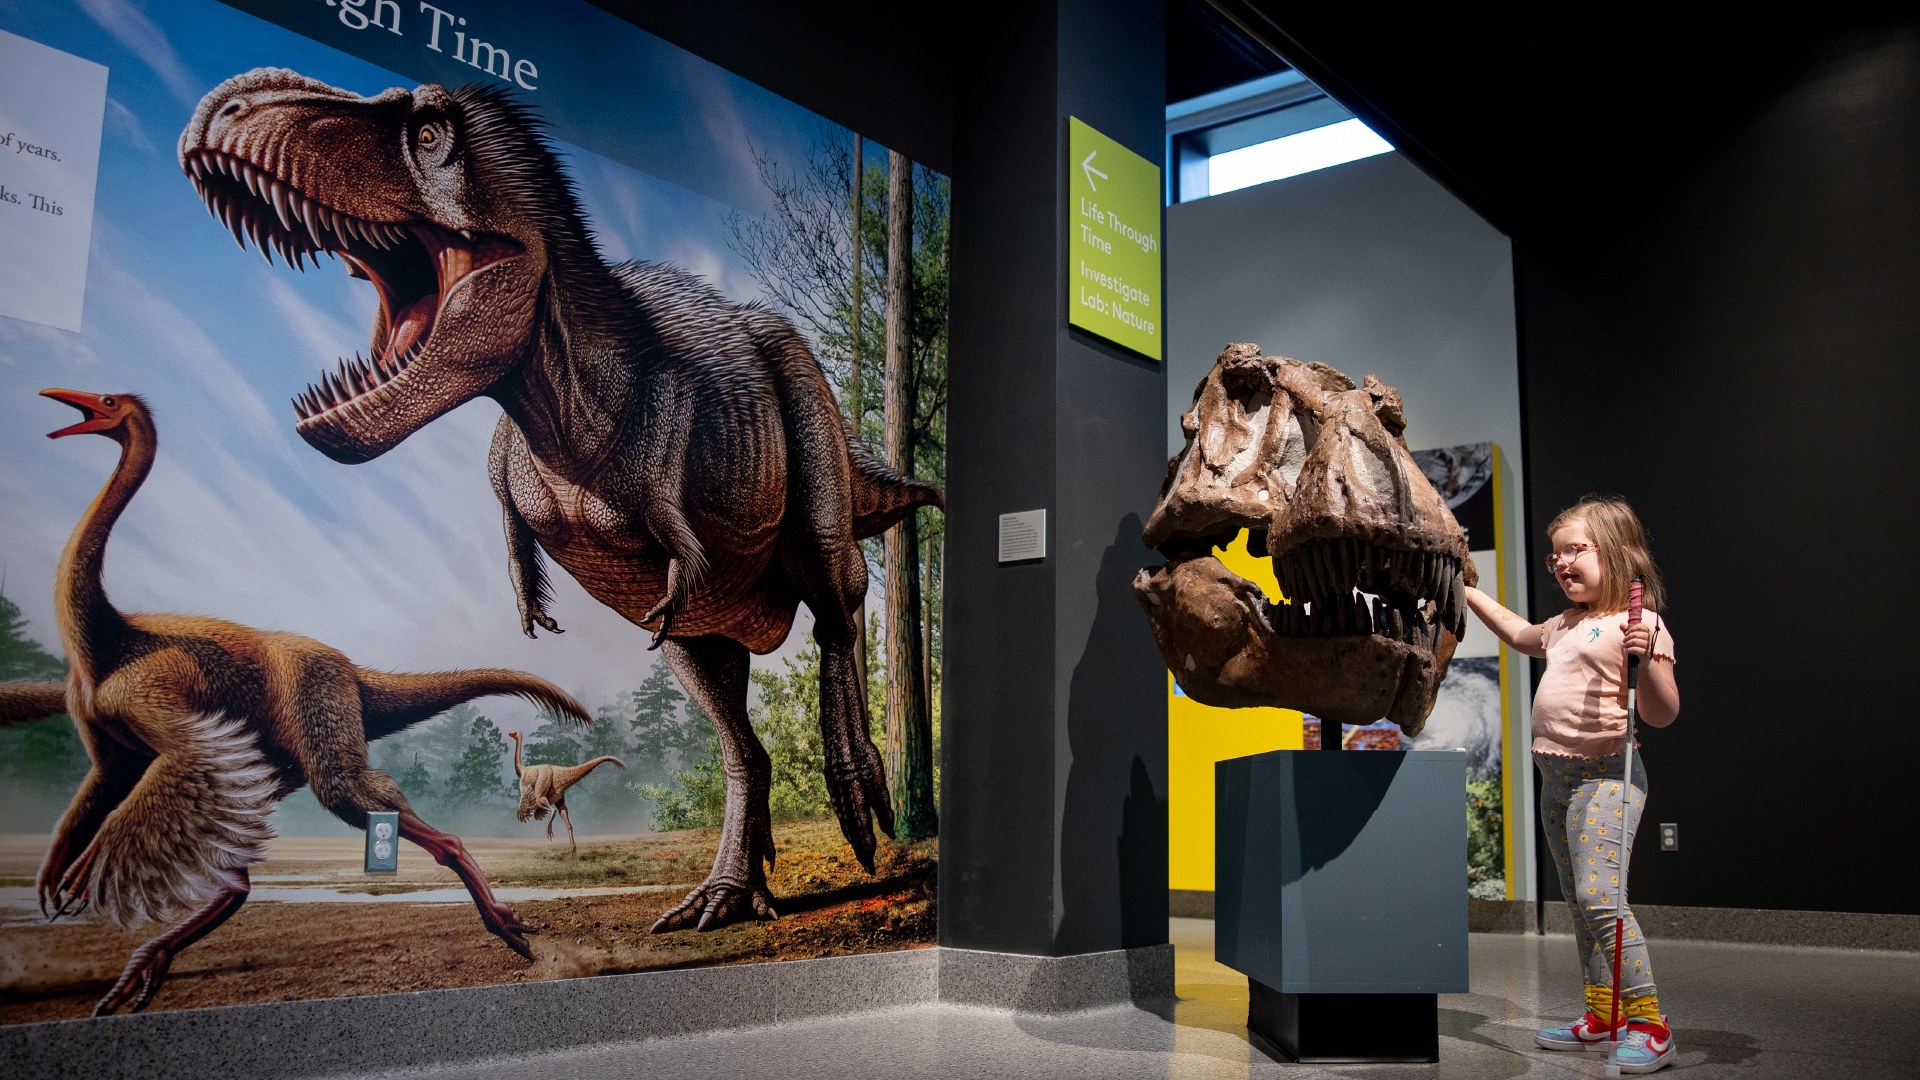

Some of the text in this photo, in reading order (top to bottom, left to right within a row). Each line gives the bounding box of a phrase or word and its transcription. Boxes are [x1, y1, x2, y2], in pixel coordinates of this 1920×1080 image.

[420, 1, 538, 91] Time
[16, 140, 61, 162] years.
[28, 193, 64, 216] This
[1081, 197, 1157, 253] Life Through
[1080, 224, 1112, 255] Time
[1081, 260, 1150, 307] Investigate
[1081, 286, 1155, 335] Lab: Nature
